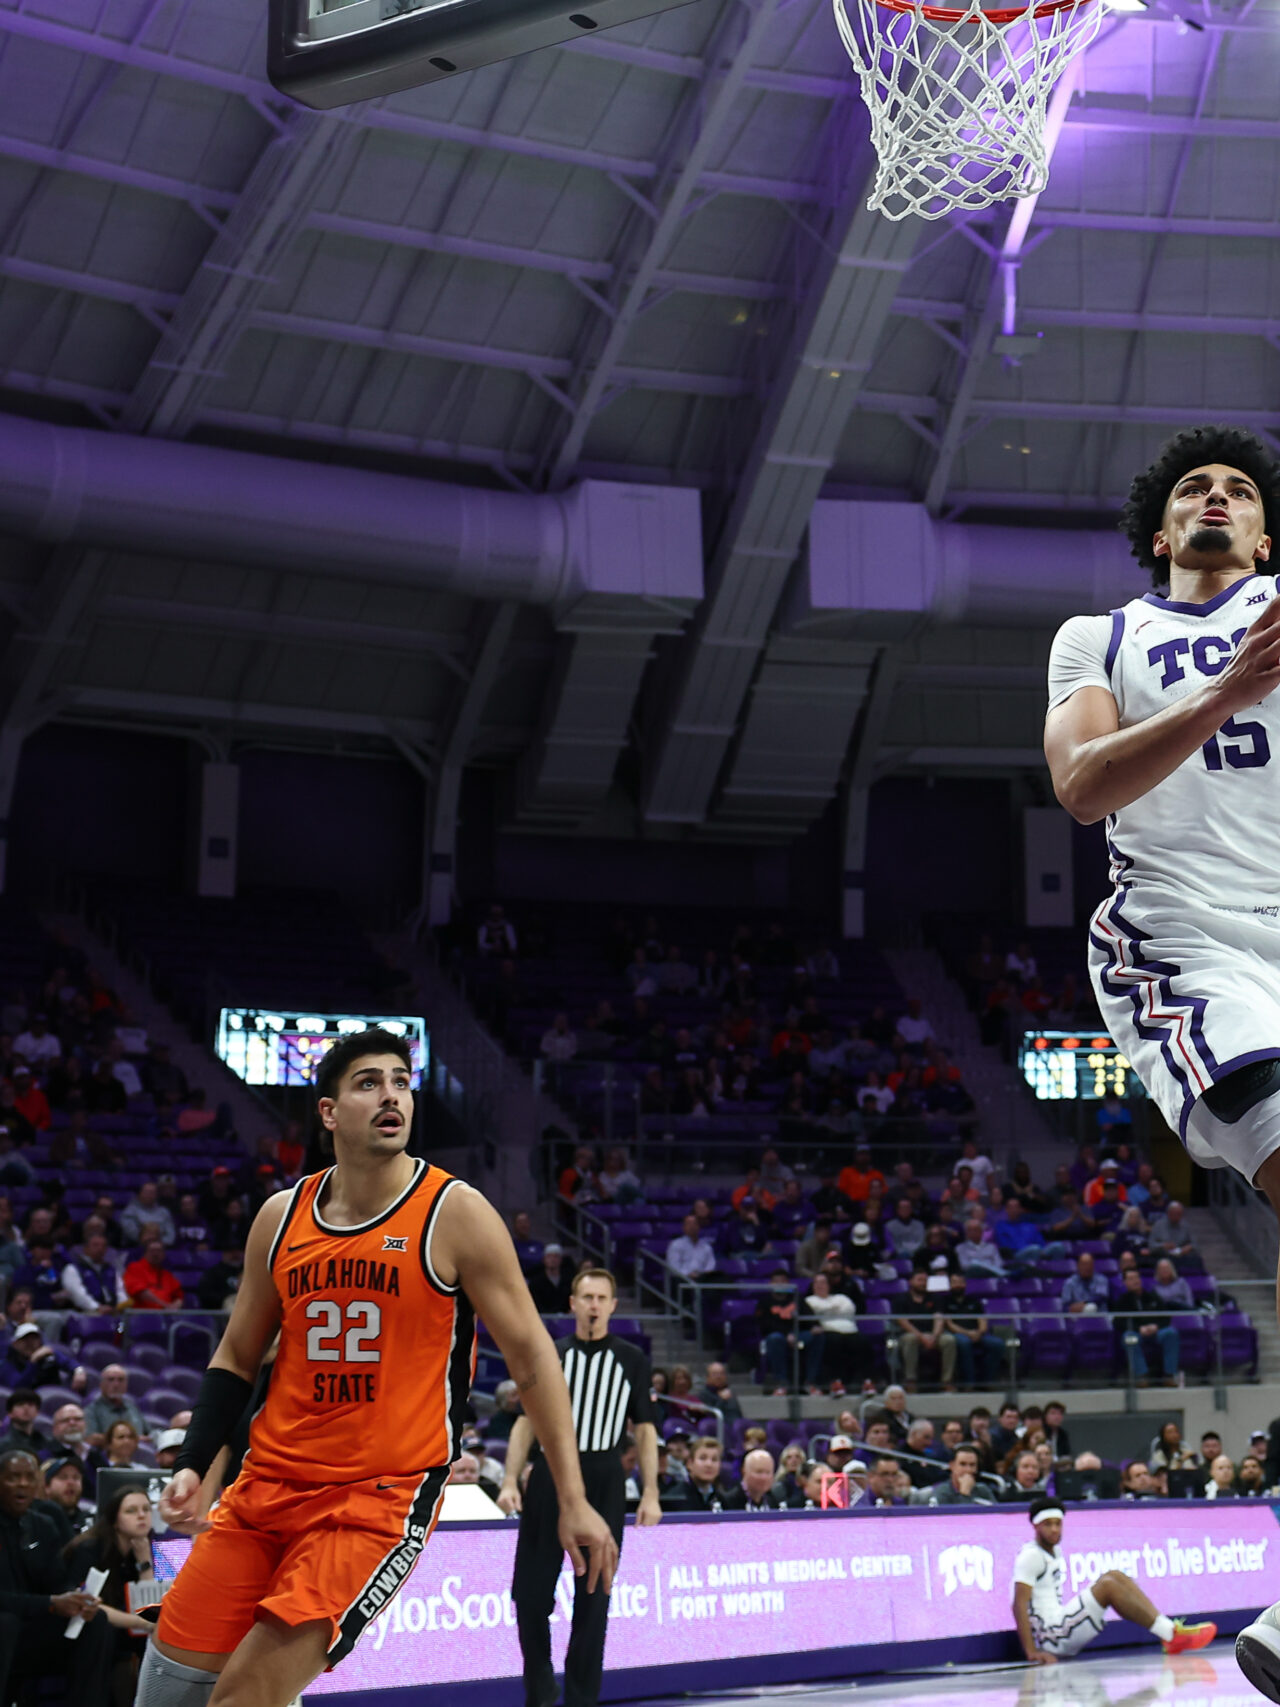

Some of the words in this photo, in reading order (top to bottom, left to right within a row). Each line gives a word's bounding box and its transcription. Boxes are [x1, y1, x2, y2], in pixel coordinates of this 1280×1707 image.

[288, 1258, 400, 1298] OKLAHOMA
[305, 1300, 381, 1362] 22
[313, 1372, 375, 1403] STATE
[668, 1565, 703, 1590] ALL
[707, 1562, 769, 1587] SAINTS
[773, 1557, 847, 1583] MEDICAL
[850, 1554, 913, 1578] CENTER
[1069, 1548, 1140, 1592] power
[1143, 1542, 1165, 1578] to
[1167, 1538, 1204, 1577] live
[671, 1594, 717, 1620] FORT
[722, 1590, 784, 1616] WORTH
